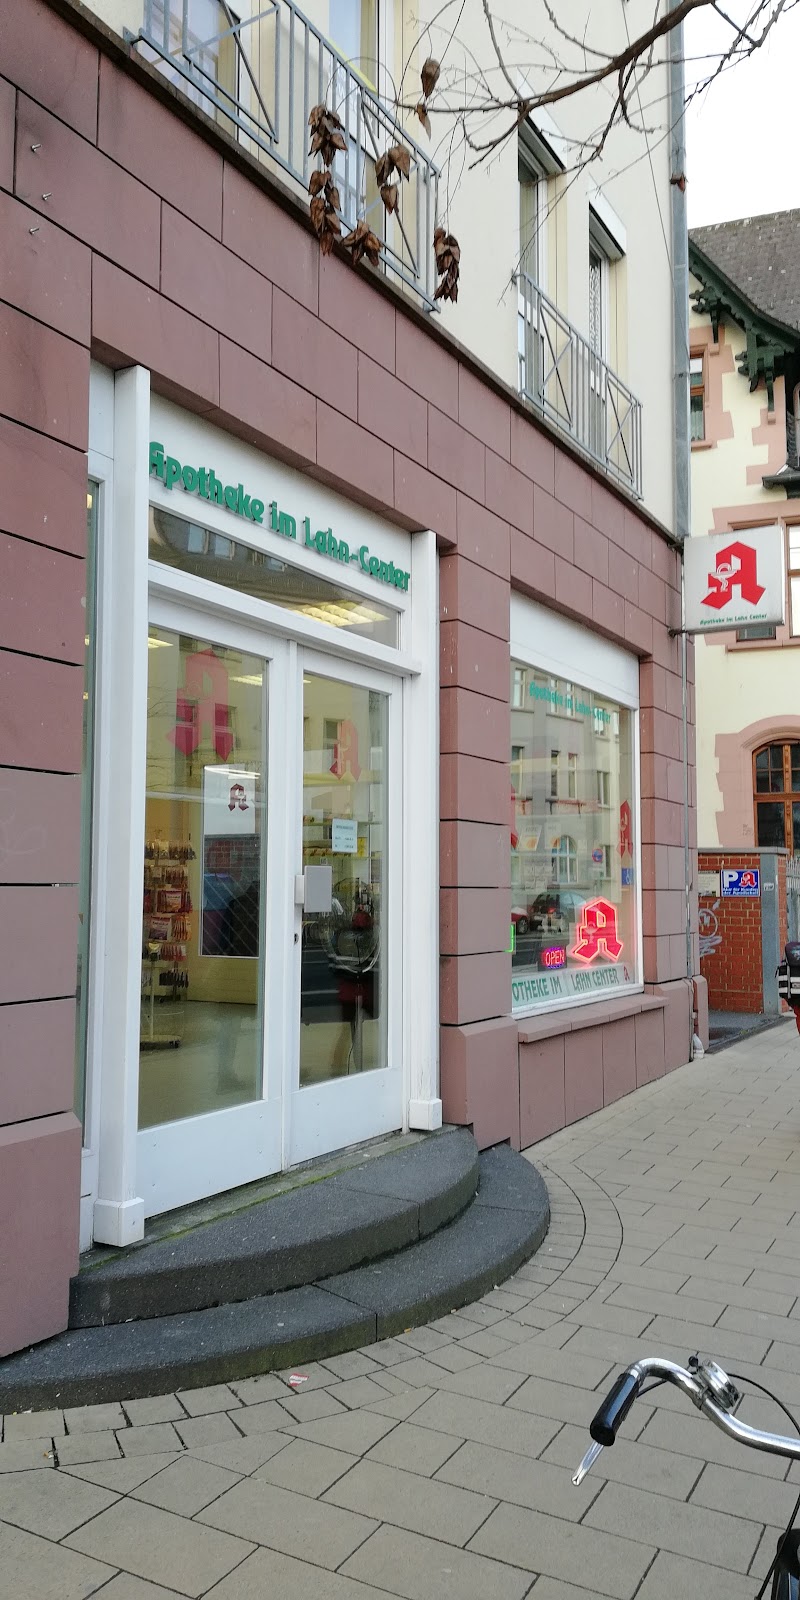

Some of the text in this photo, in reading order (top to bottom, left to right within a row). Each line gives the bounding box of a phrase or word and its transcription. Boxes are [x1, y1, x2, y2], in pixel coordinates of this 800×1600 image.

[149, 441, 410, 592] Apotheke im Lahn-Center
[723, 870, 738, 887] P
[545, 949, 565, 966] OPEN
[551, 976, 562, 995] IM
[571, 973, 591, 991] LAHN
[592, 968, 619, 987] CENTER
